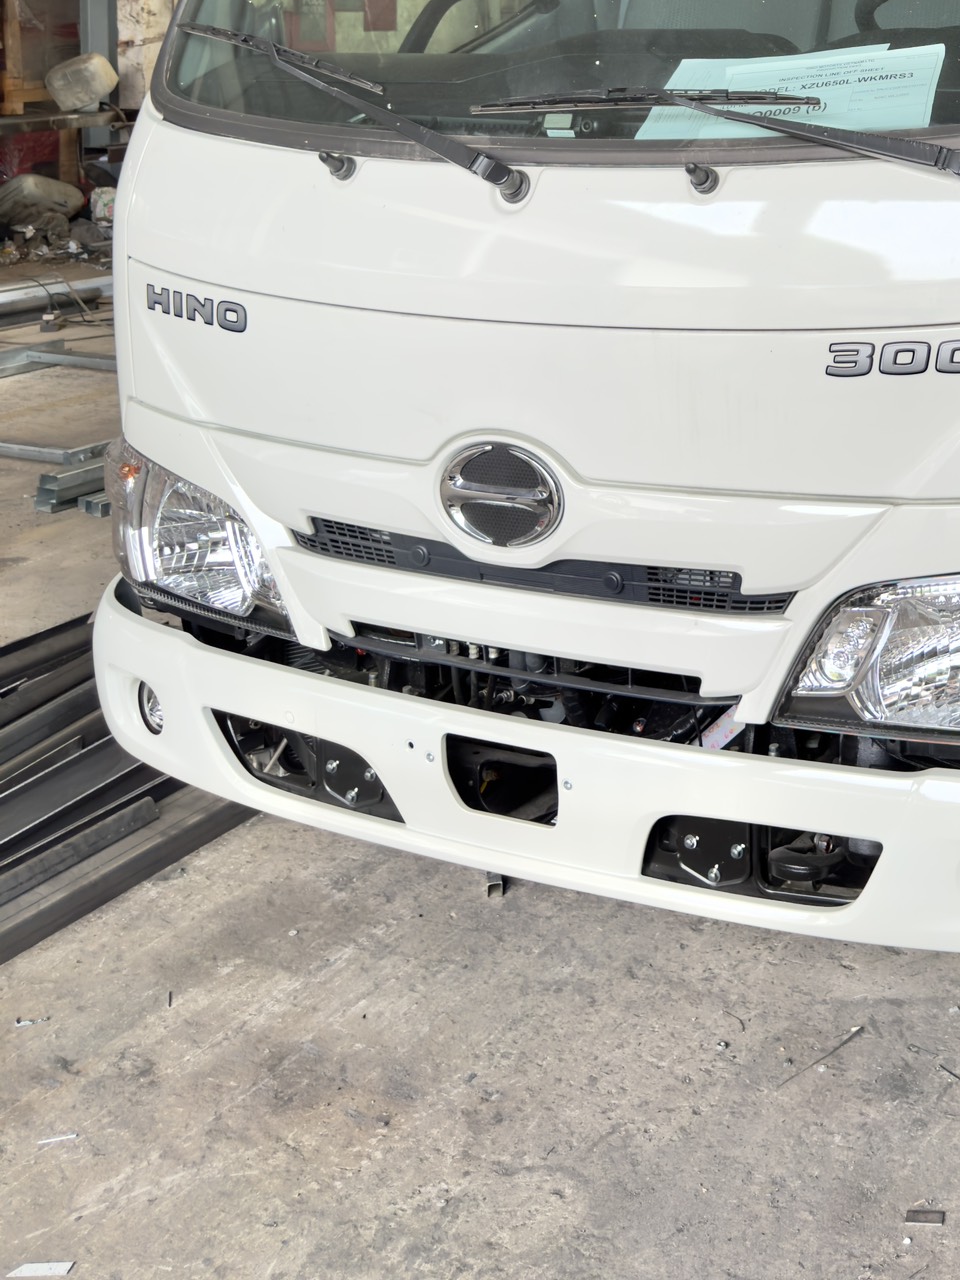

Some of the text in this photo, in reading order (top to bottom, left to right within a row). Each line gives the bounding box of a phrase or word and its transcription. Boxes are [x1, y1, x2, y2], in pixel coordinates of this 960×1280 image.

[779, 73, 823, 83] INSPECTION
[800, 72, 914, 91] XZU650L-WKMRS3
[146, 283, 248, 333] HINO
